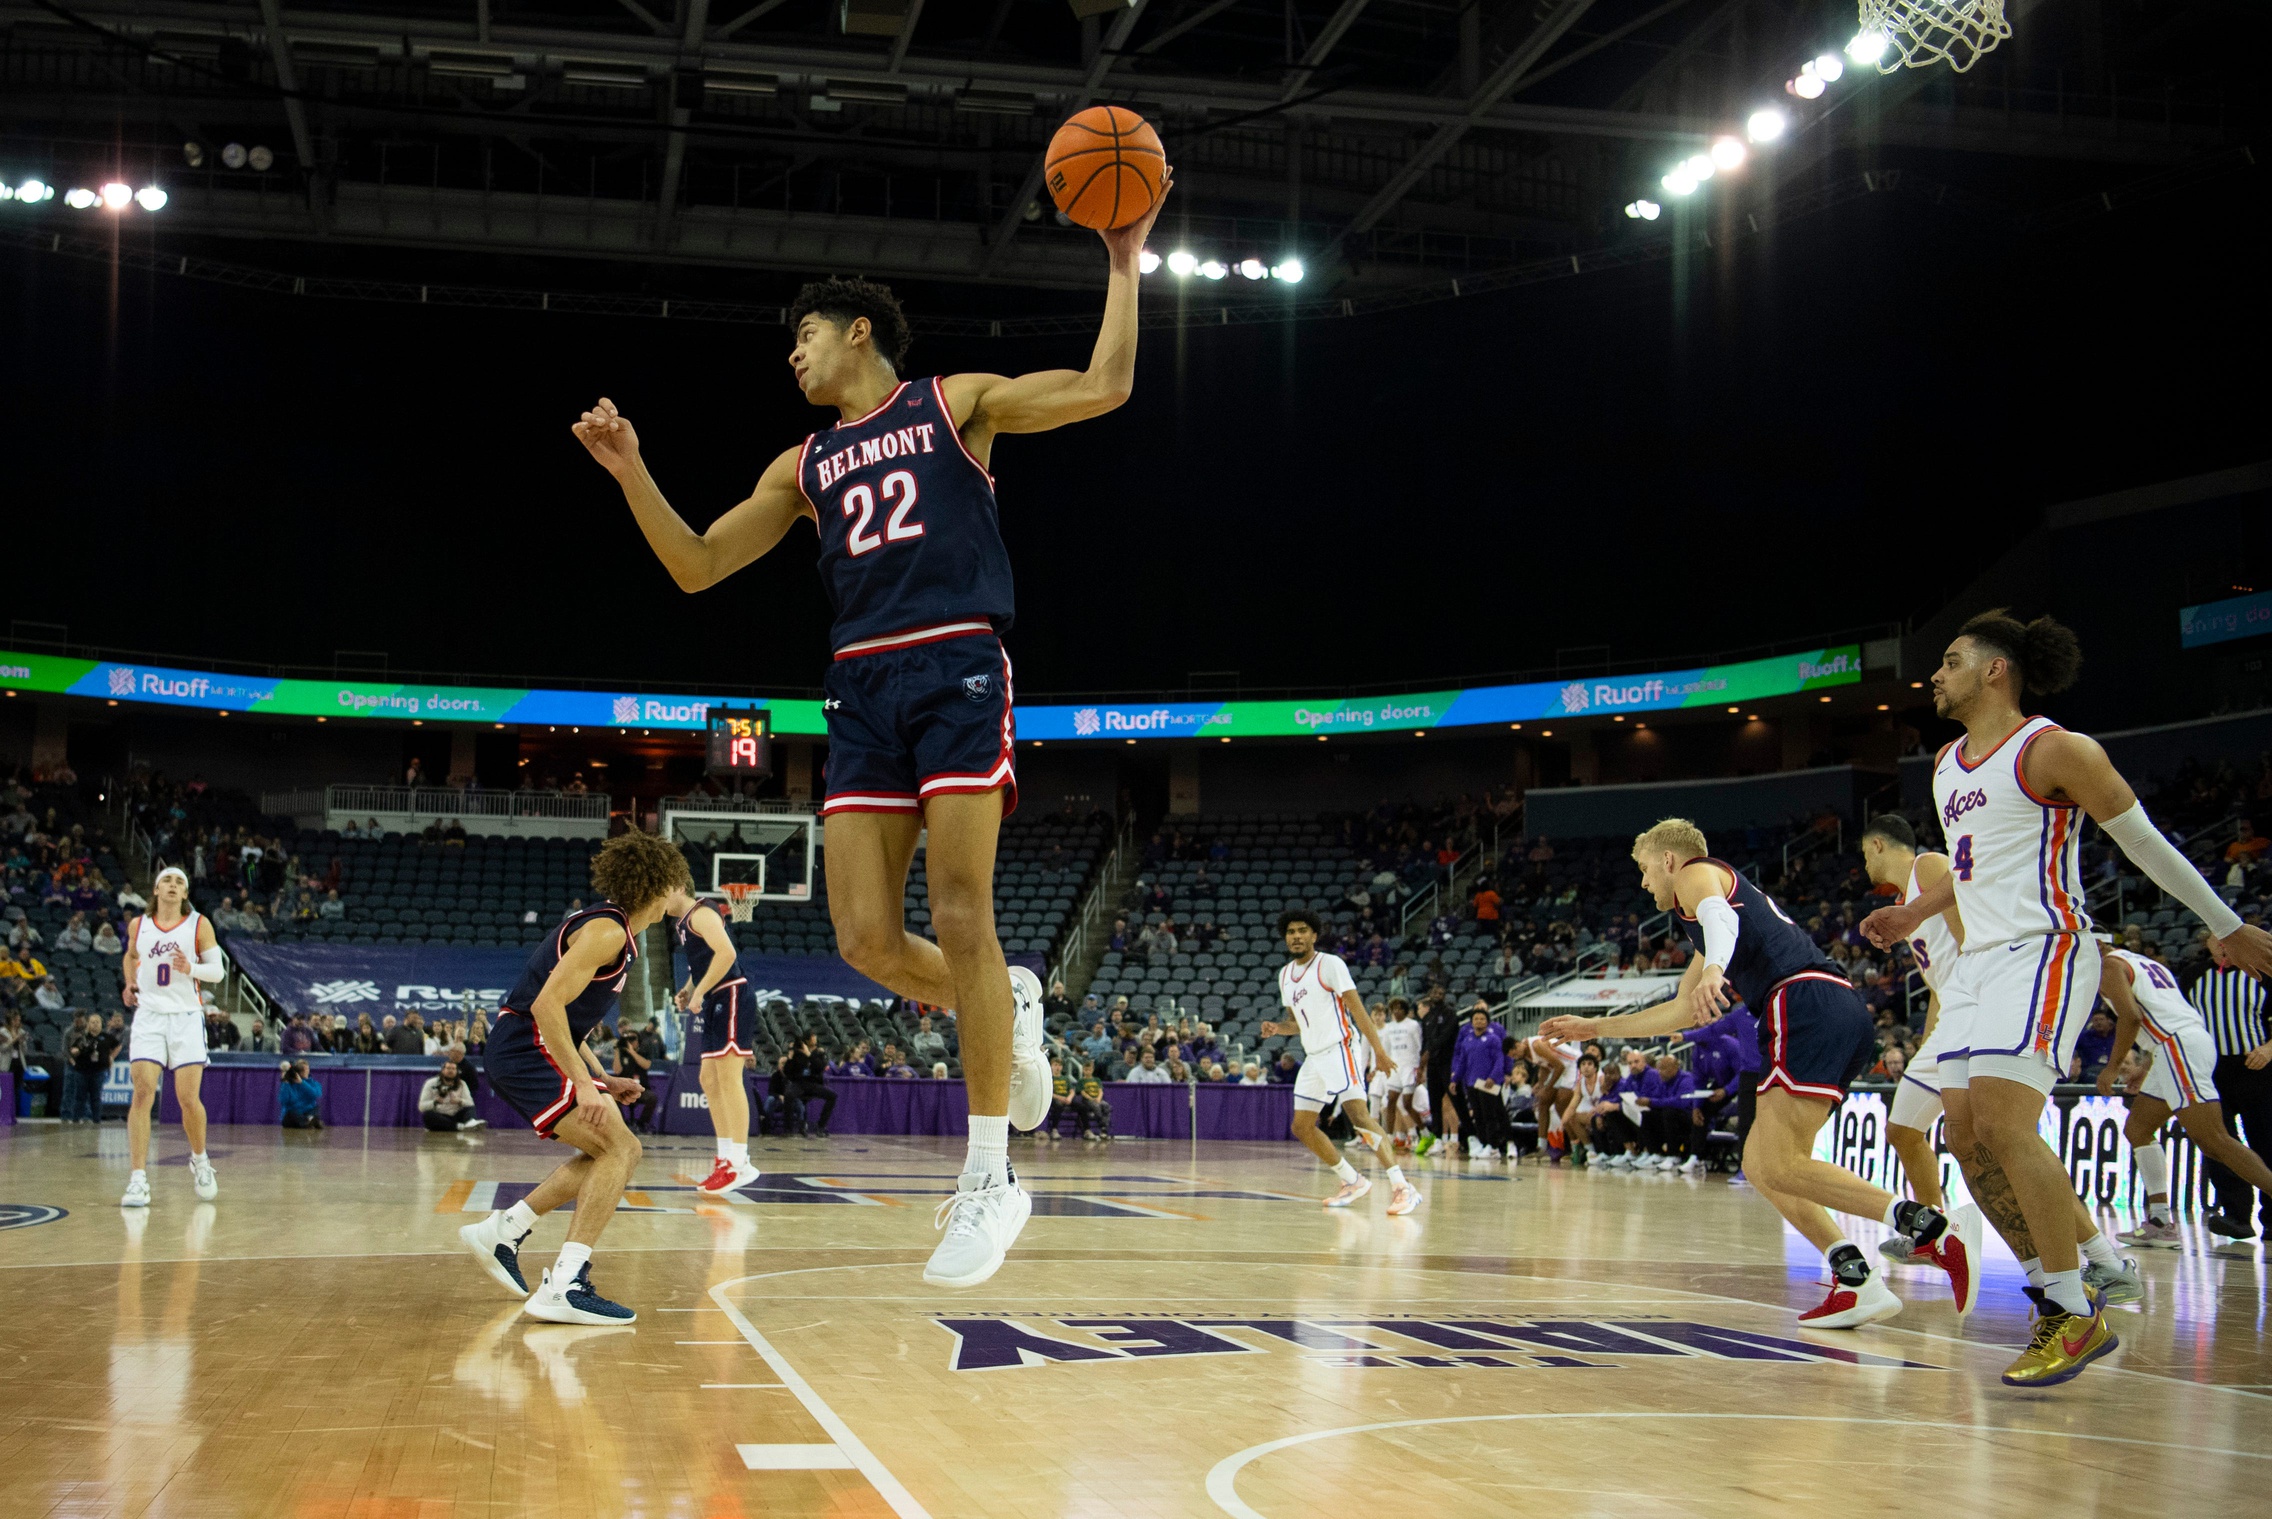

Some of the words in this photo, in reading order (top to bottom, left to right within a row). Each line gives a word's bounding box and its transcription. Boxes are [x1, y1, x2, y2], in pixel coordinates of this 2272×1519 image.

[816, 422, 935, 492] BELMONT
[841, 469, 925, 558] 22
[141, 672, 209, 698] Ruoff
[1594, 678, 1664, 707] Ruoff
[337, 689, 420, 714] Opening
[426, 694, 486, 712] doors.
[644, 700, 710, 722] Ruoff
[727, 717, 763, 737] 7:51
[1105, 709, 1169, 731] Ruoff
[1293, 704, 1374, 729] Opening
[730, 737, 757, 767] 19
[1943, 787, 1988, 828] Aces
[1952, 834, 1974, 882] 4
[148, 940, 180, 959] Aces
[157, 963, 171, 987] 0
[2139, 961, 2176, 989] 20
[397, 985, 507, 1000] Ruo
[930, 1318, 1960, 1372] VALLEY
